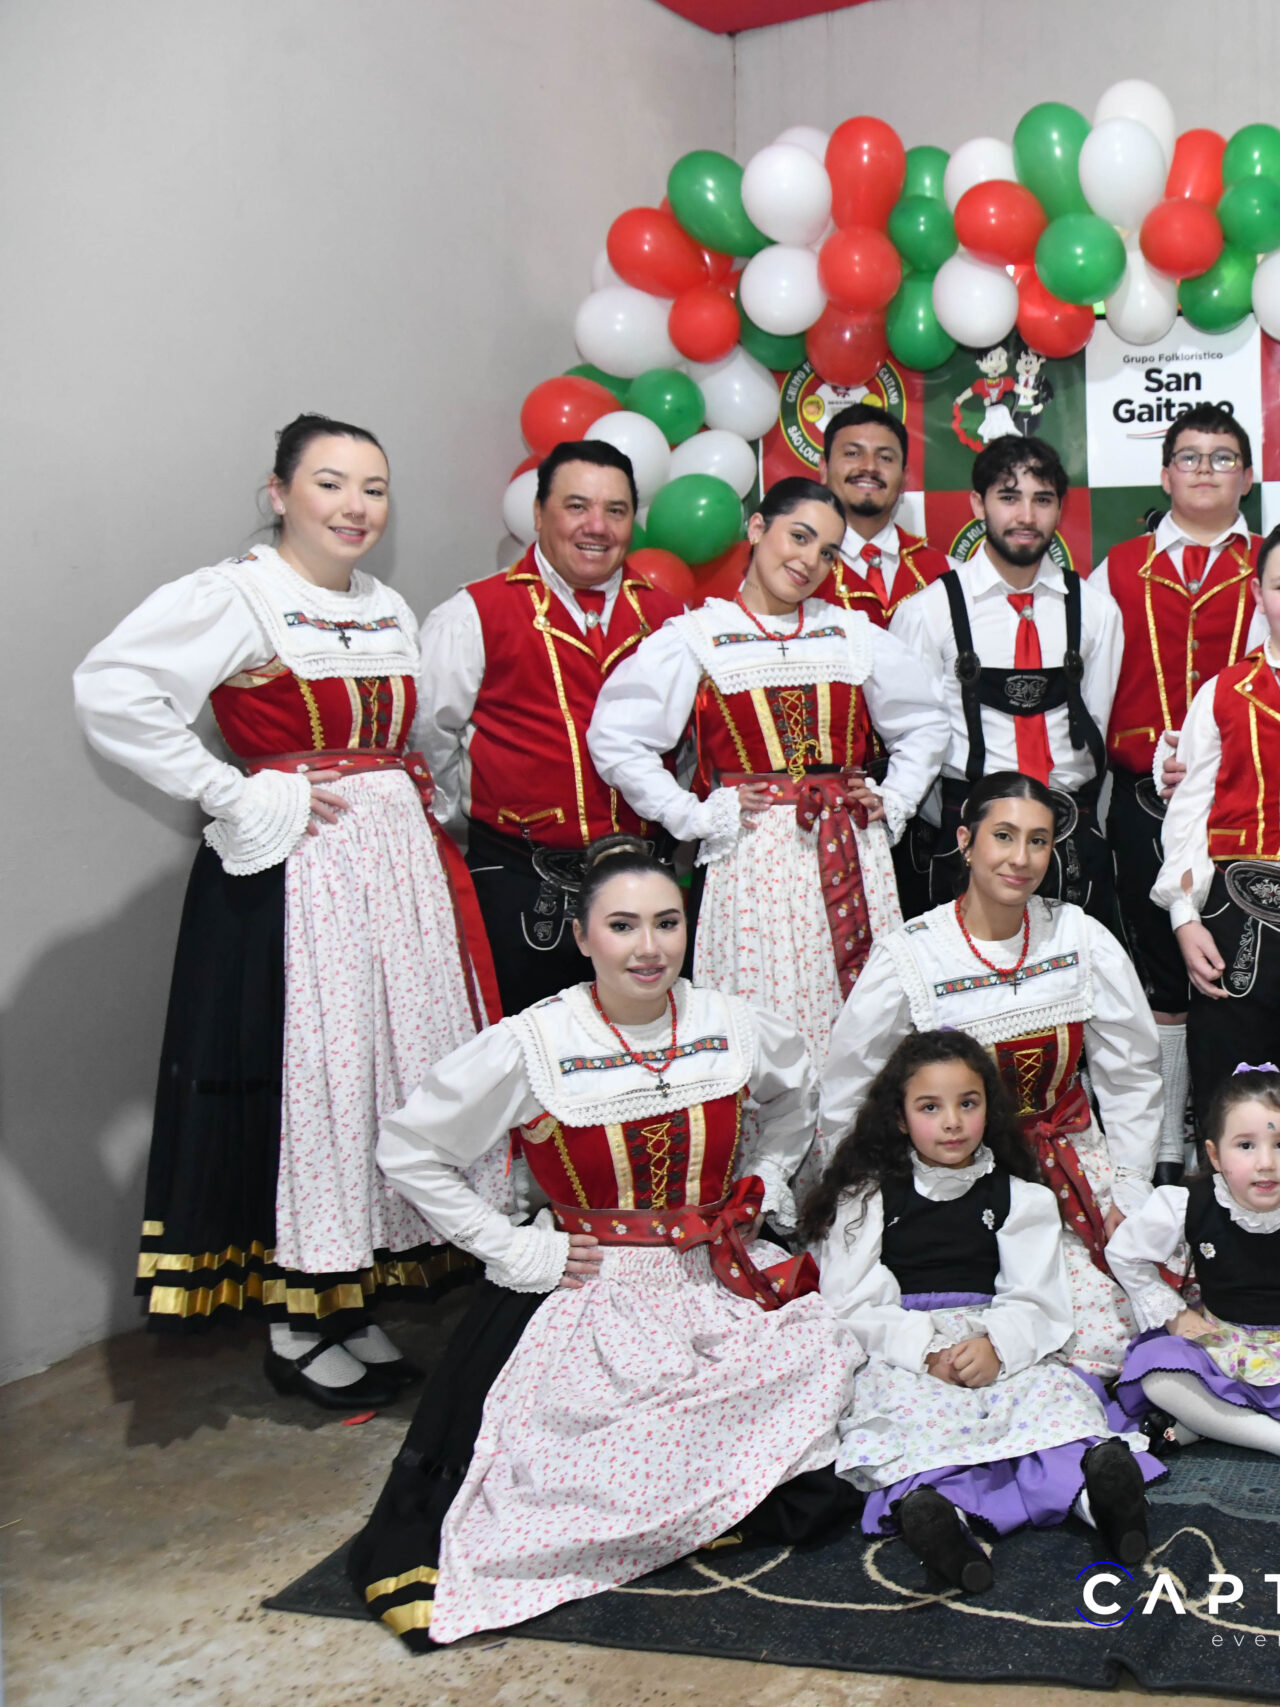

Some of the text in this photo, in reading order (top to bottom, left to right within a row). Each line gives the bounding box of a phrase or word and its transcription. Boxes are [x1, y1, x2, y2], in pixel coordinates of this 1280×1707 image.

[1122, 354, 1155, 364] Grupo
[1144, 367, 1202, 393] San
[787, 425, 803, 447] SÃO
